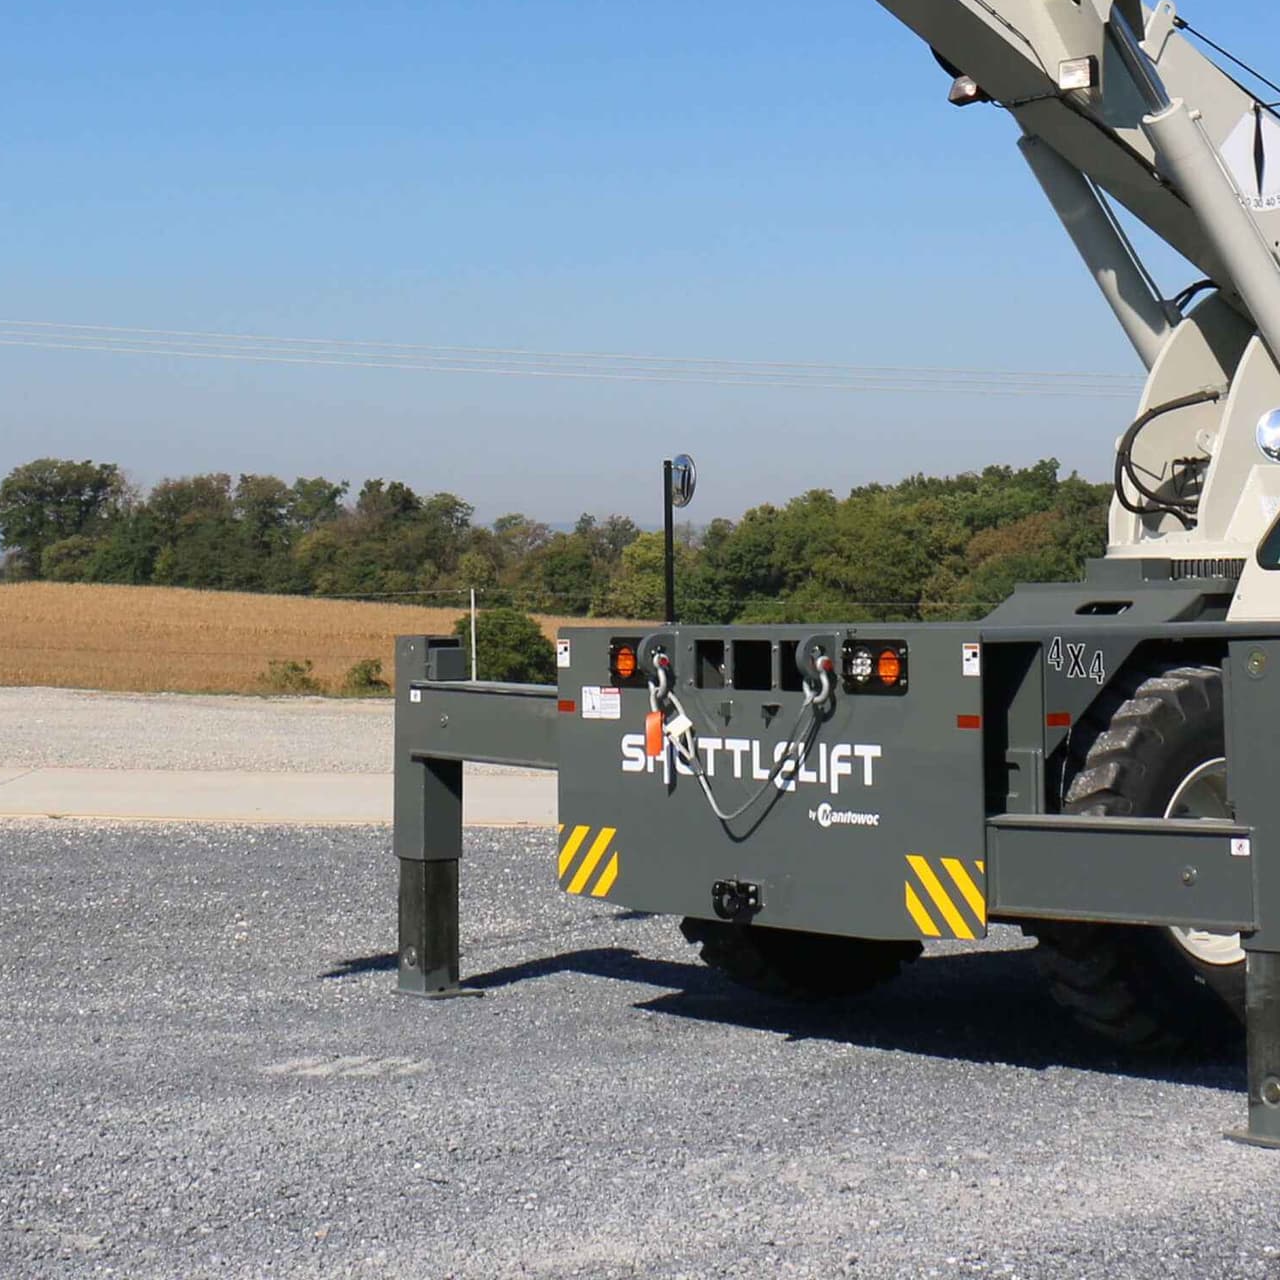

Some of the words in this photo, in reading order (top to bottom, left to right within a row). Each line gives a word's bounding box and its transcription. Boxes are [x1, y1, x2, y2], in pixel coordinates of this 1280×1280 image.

[1265, 197, 1275, 206] 40
[1047, 636, 1105, 685] 4X4
[817, 803, 879, 827] Manitowoc
